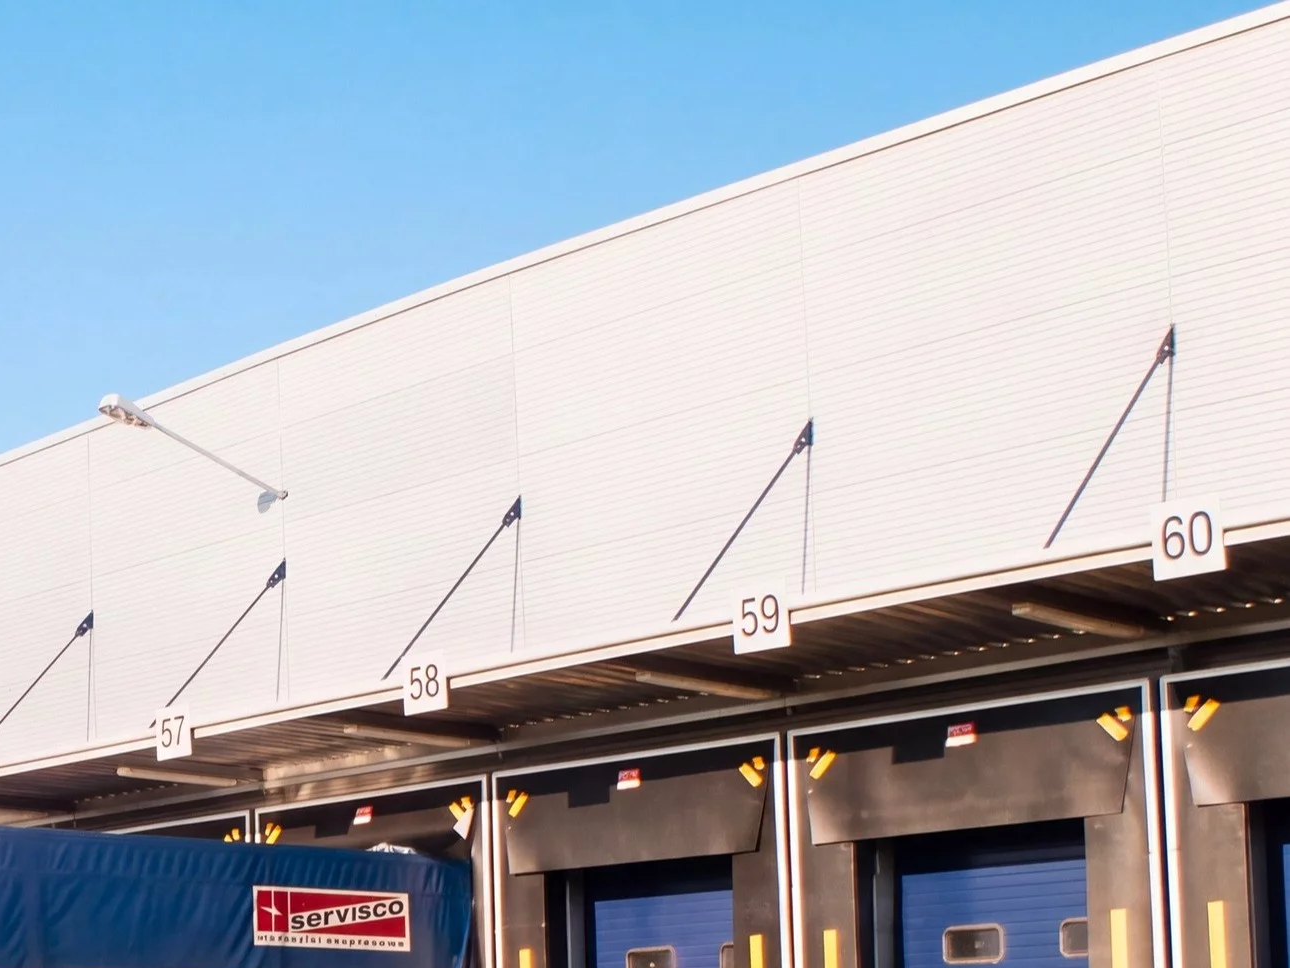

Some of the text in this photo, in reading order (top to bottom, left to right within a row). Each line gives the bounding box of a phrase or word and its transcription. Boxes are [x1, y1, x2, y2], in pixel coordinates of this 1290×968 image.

[1162, 510, 1213, 560] 60
[741, 594, 779, 637] 59
[410, 664, 439, 700] 58
[161, 715, 184, 748] 57
[290, 900, 404, 930] servisco
